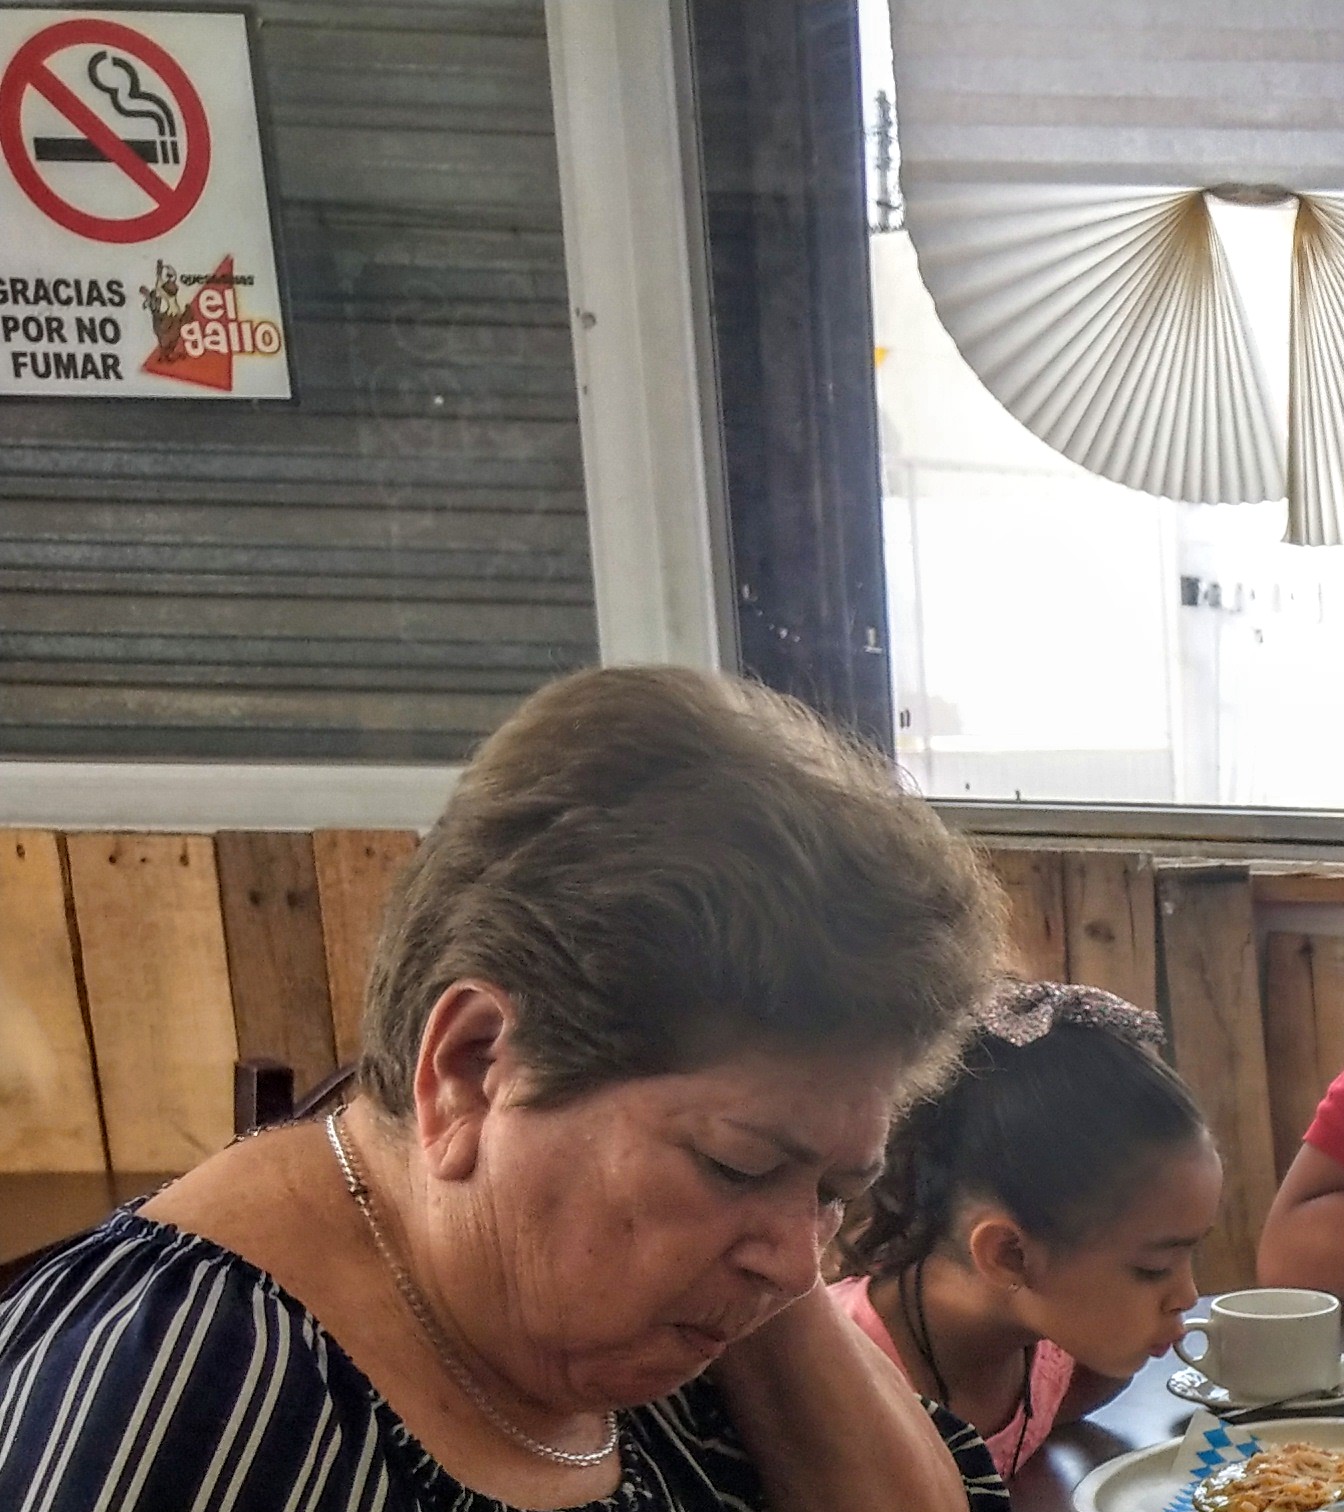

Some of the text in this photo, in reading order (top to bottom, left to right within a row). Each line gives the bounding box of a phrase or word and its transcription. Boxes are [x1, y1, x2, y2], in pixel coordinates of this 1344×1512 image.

[199, 287, 238, 321] el
[1, 315, 121, 345] POR NO
[180, 320, 281, 358] gallo
[11, 351, 124, 380] FUMAR
